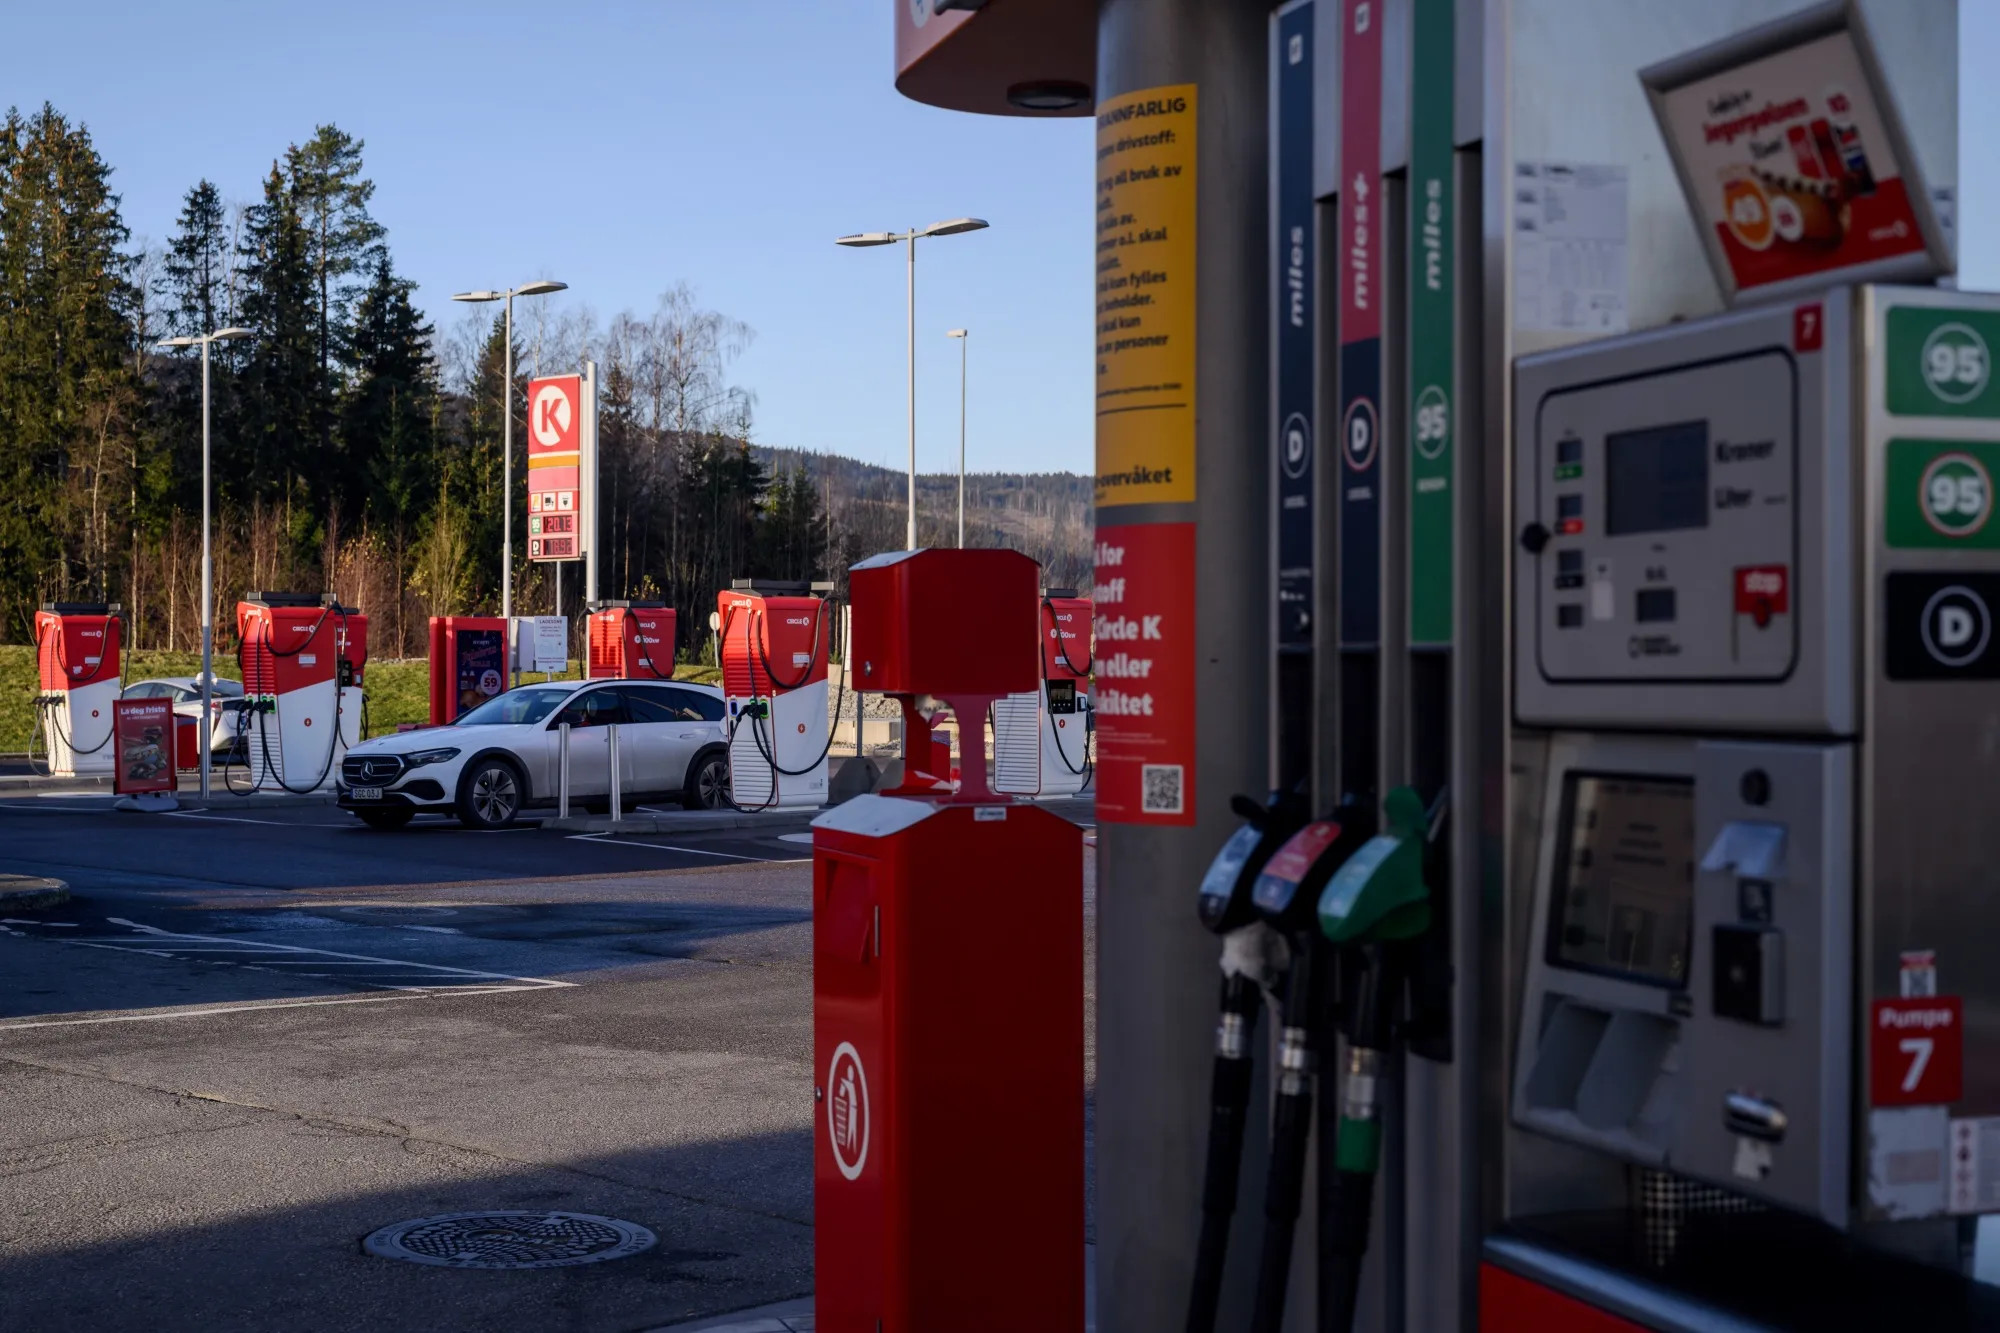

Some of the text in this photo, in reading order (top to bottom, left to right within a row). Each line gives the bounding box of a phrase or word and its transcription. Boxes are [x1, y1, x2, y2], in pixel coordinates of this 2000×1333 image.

[1117, 129, 1176, 152] drivstoff:
[1130, 165, 1159, 182] bruk
[1164, 166, 1182, 177] av
[1139, 226, 1167, 243] skal
[1352, 172, 1369, 310] miles+
[1423, 179, 1441, 291] miles
[1130, 269, 1167, 289] fylles
[1289, 226, 1304, 327] miles
[1119, 315, 1141, 328] kun
[1801, 312, 1816, 340] 7
[1114, 335, 1169, 354] personer
[1928, 343, 1983, 384] 95
[1352, 417, 1369, 452] D
[1417, 404, 1446, 441] 95
[1289, 429, 1304, 463] D
[1714, 439, 1775, 463] Kroner
[1930, 475, 1983, 515] 95
[533, 540, 539, 551] D
[1101, 541, 1124, 566] for
[1745, 570, 1782, 595] stop
[1142, 614, 1161, 641] K
[1939, 607, 1974, 647] D
[484, 677, 497, 688] 59
[130, 707, 144, 715] deg
[145, 706, 166, 714] friste
[1879, 1006, 1952, 1029] Pumpe
[1900, 1038, 1934, 1092] 7
